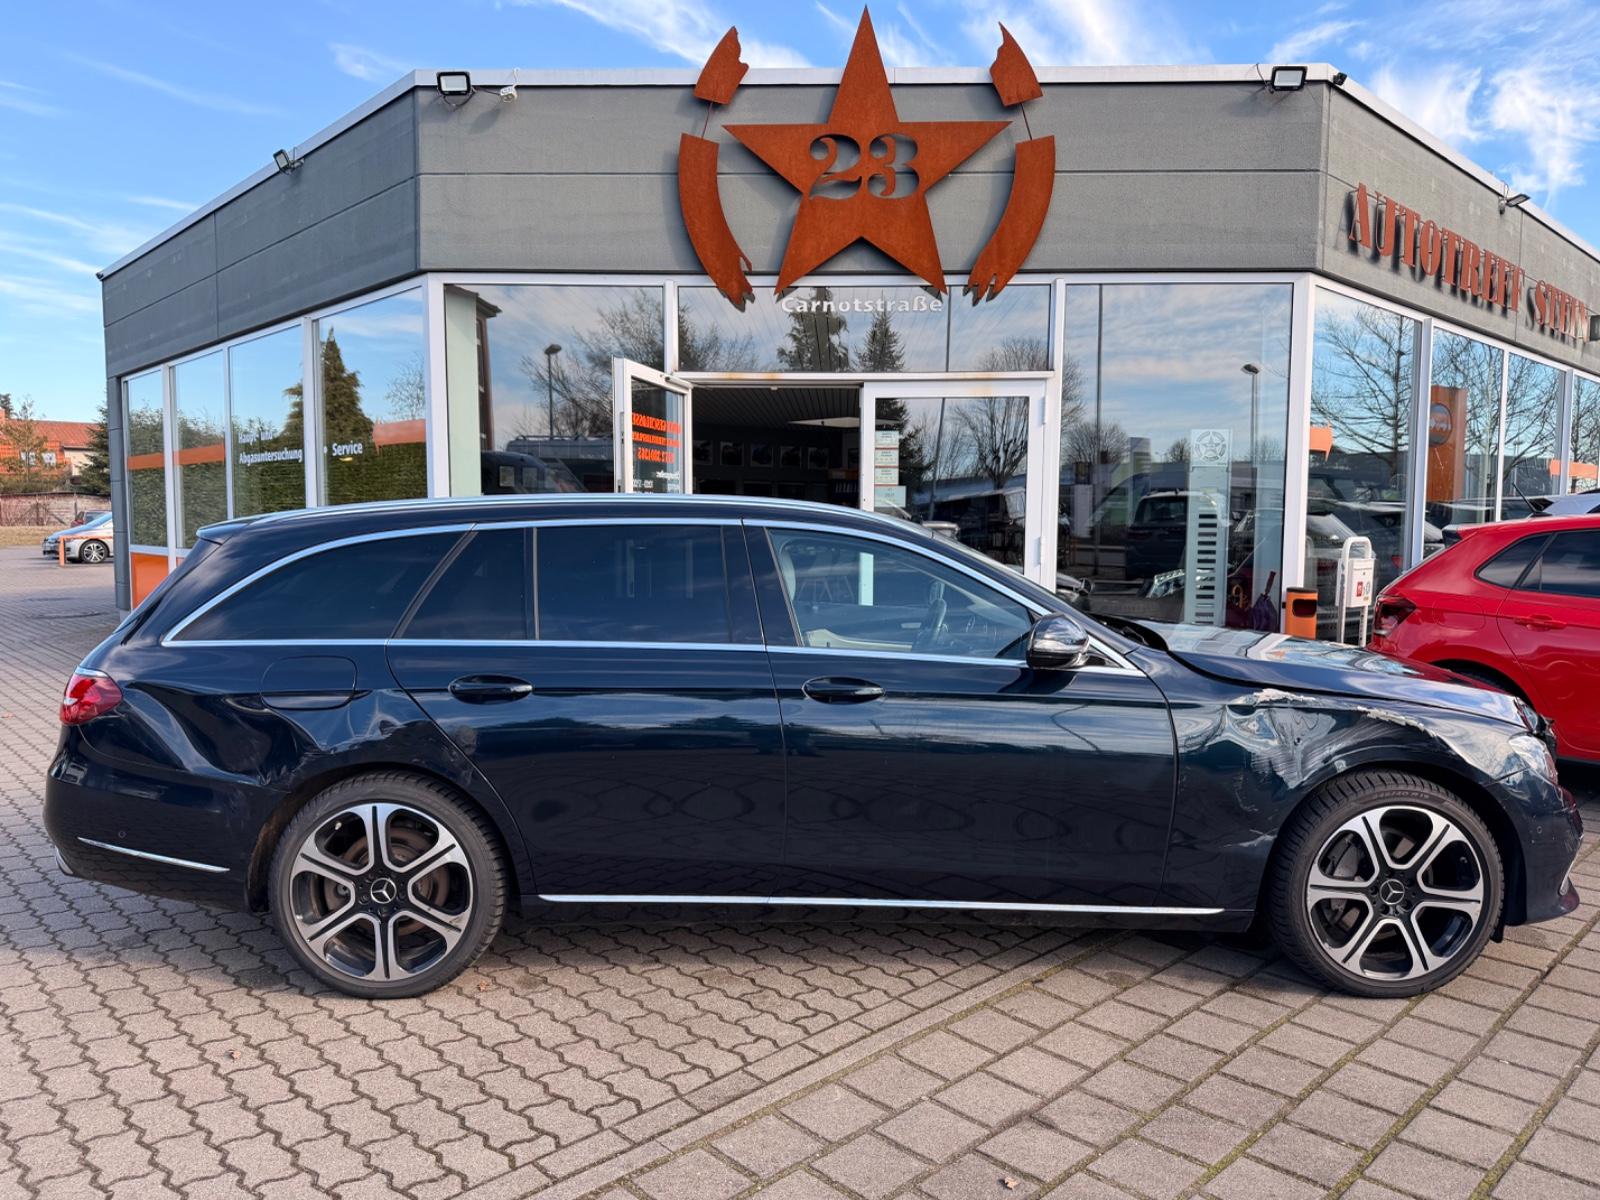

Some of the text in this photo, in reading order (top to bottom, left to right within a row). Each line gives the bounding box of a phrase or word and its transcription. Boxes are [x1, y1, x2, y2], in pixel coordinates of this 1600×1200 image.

[809, 134, 920, 200] 23
[781, 295, 943, 313] Carnotstraße
[239, 447, 302, 466] Abgasuntersuchung
[332, 440, 363, 456] Service
